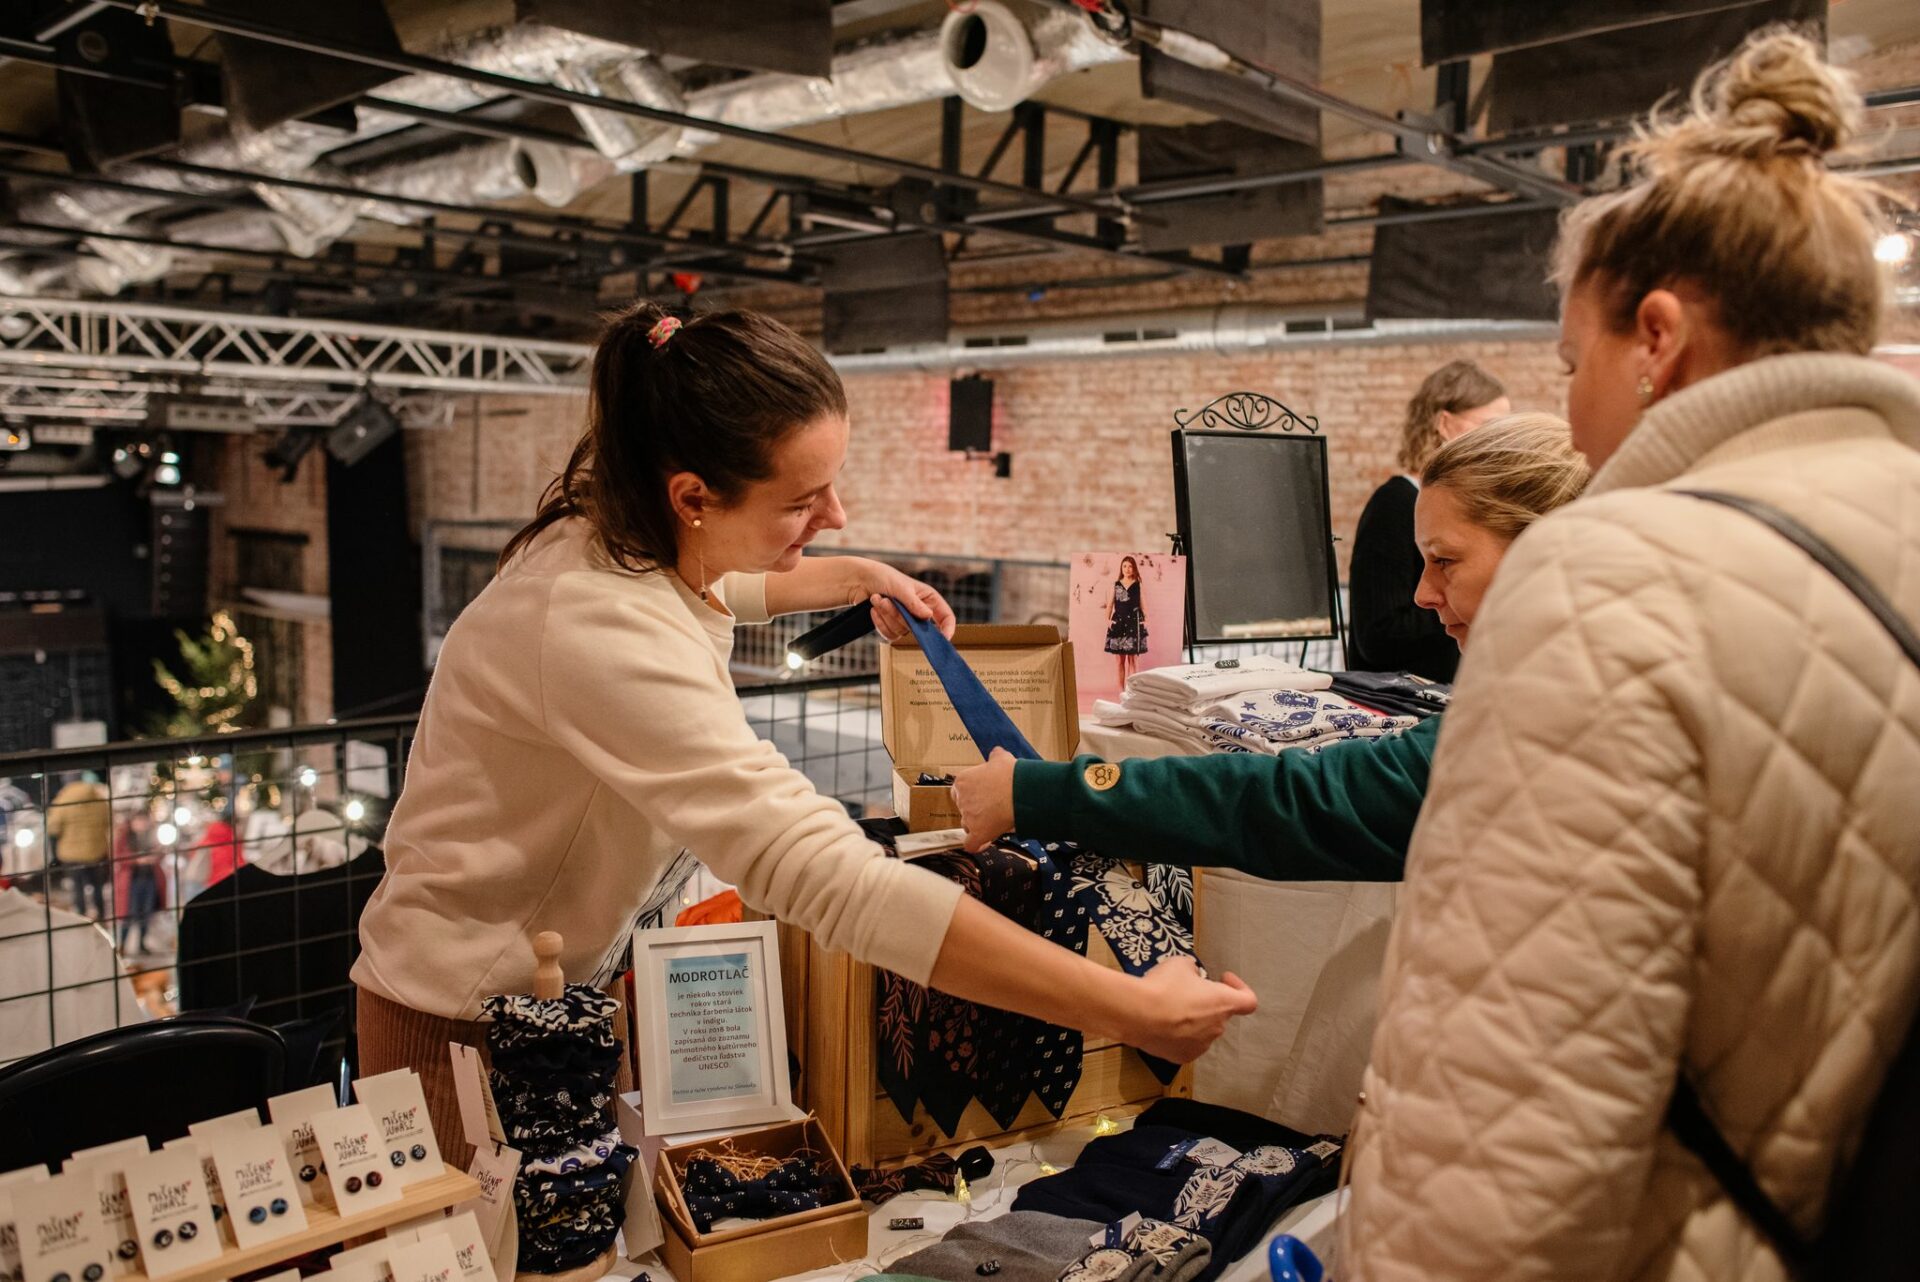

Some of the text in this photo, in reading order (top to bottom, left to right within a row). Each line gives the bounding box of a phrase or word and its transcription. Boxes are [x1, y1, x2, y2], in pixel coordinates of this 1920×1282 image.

[669, 966, 750, 984] MODROTLAČ
[677, 991, 685, 1000] je
[718, 988, 743, 997] stoviek
[713, 998, 732, 1006] stará
[670, 1005, 752, 1018] technika farbenia látok
[708, 1026, 725, 1034] 2018
[726, 1024, 741, 1032] bola
[707, 1035, 717, 1043] do
